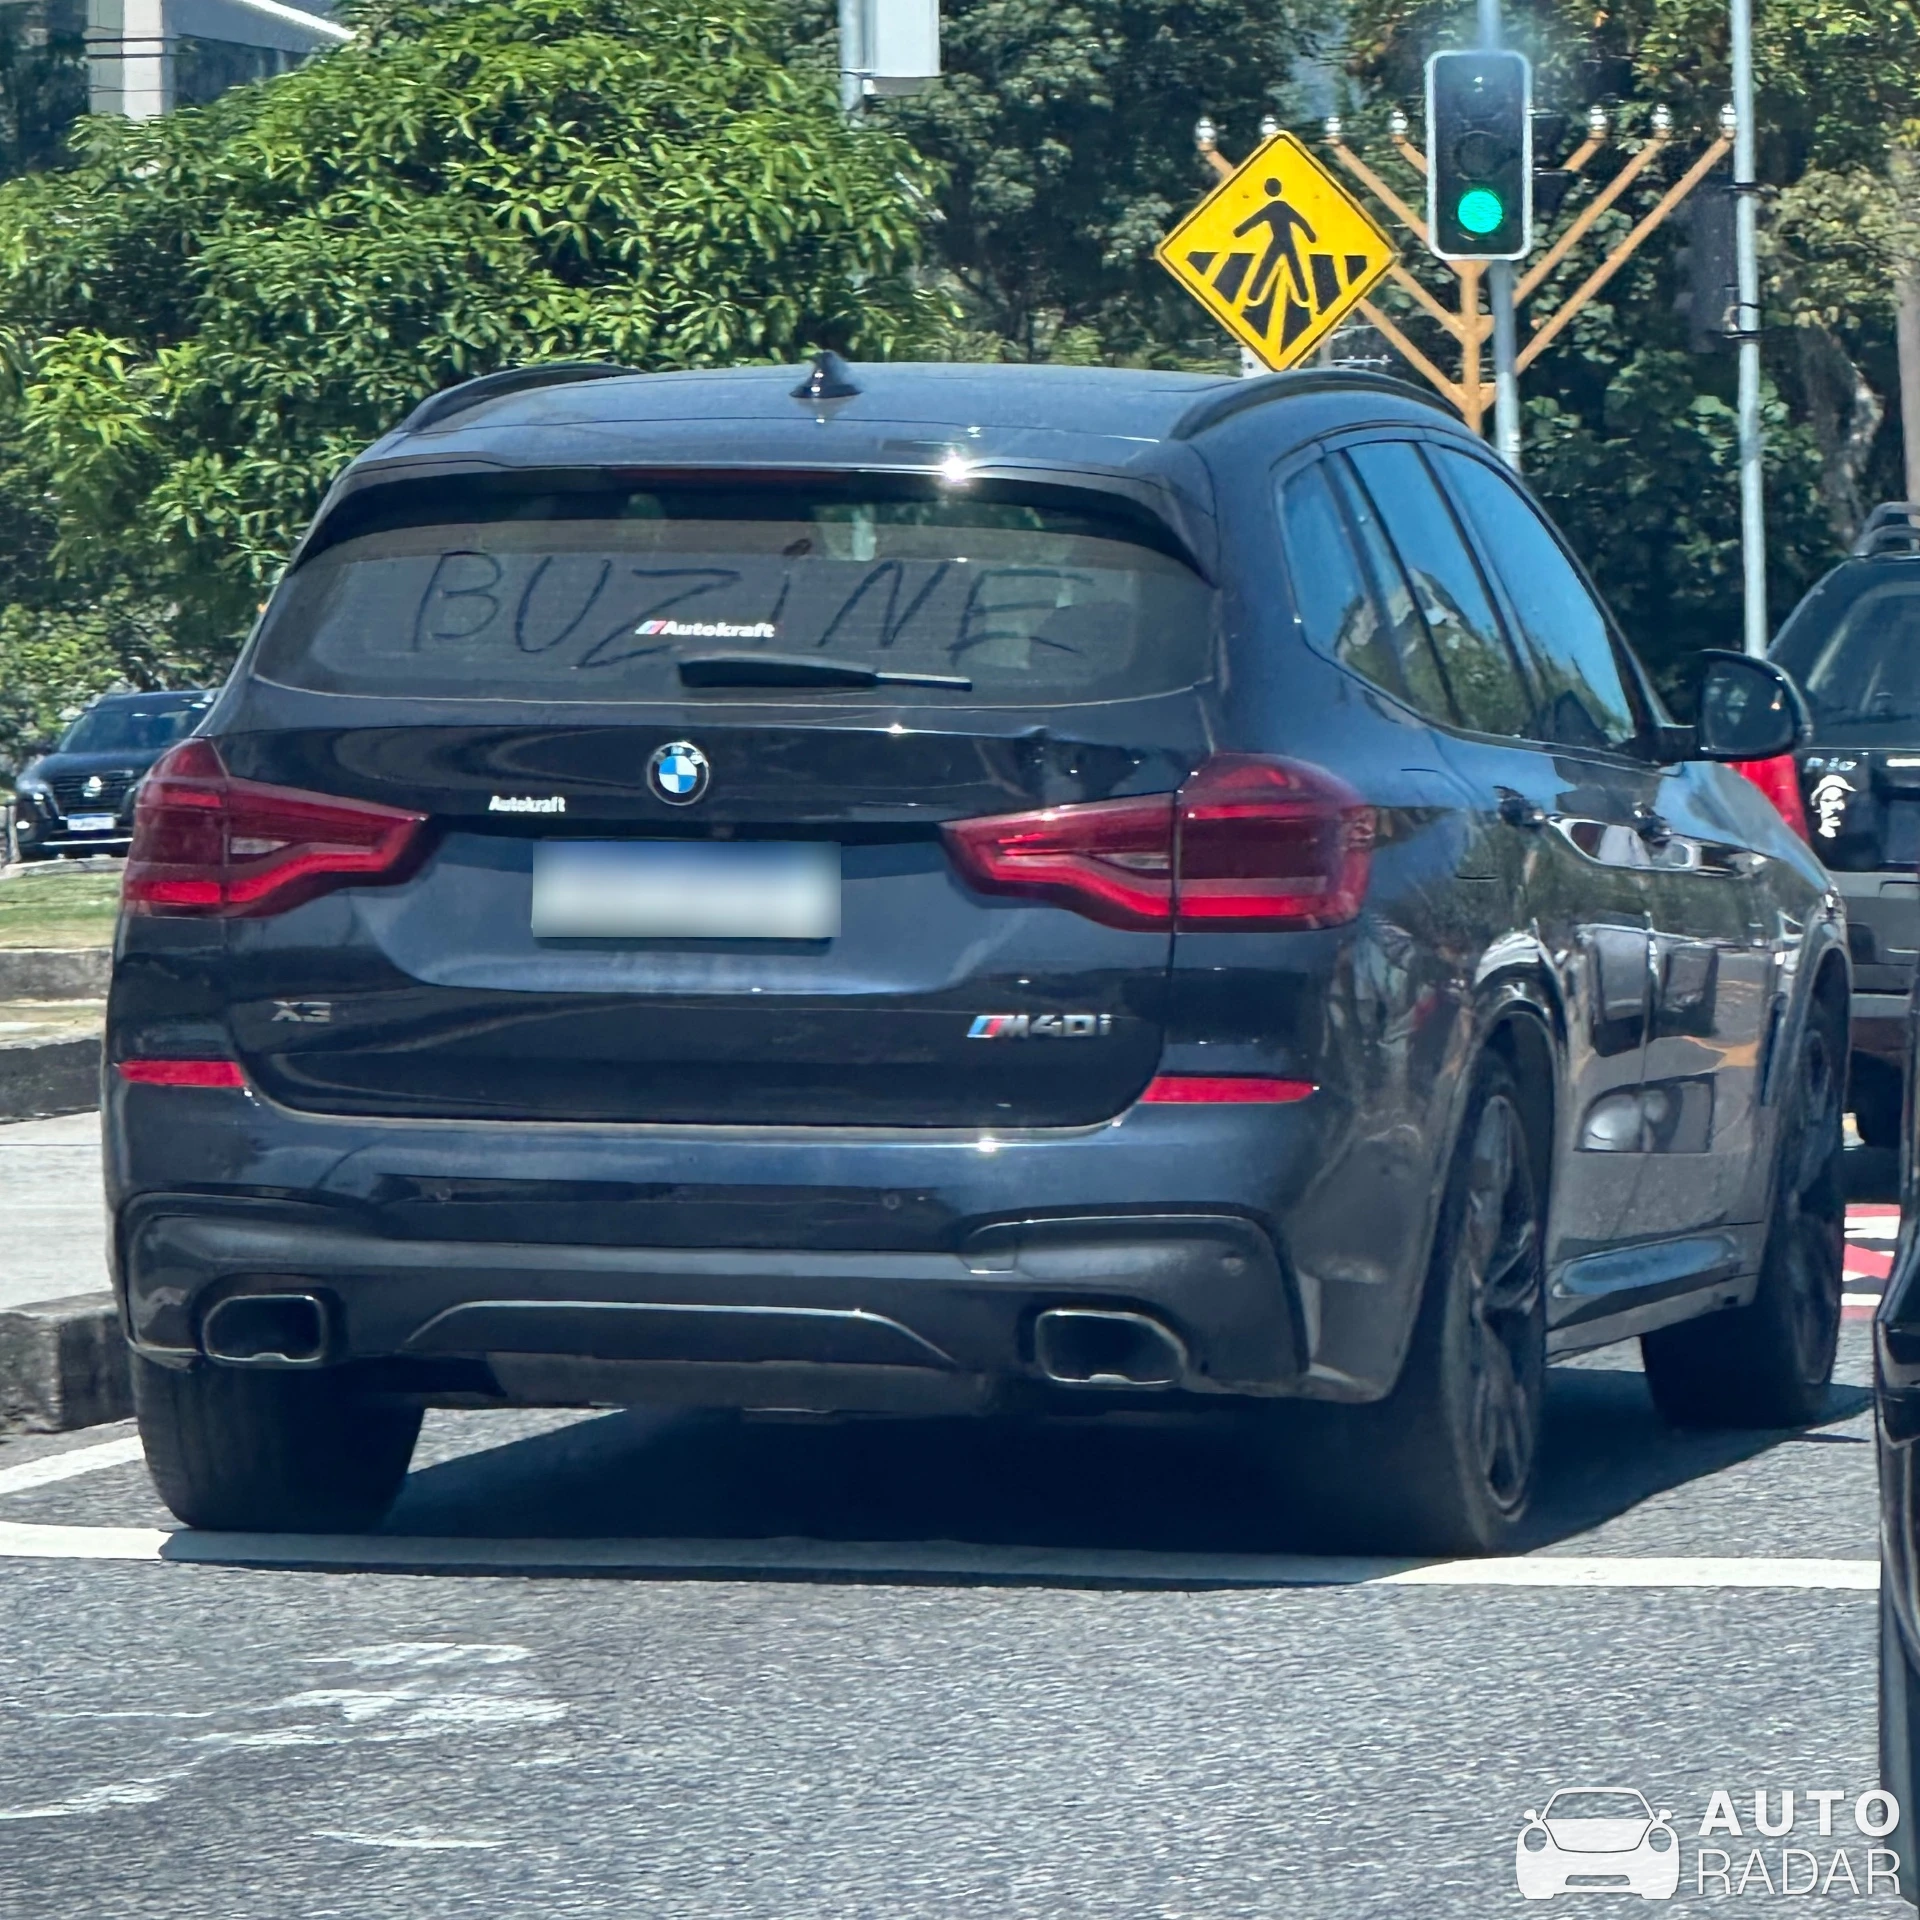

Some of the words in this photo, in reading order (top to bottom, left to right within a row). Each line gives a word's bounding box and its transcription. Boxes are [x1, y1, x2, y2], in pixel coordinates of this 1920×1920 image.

[660, 620, 776, 638] Autokraft
[271, 1001, 332, 1023] X3
[996, 1013, 1112, 1038] M40i
